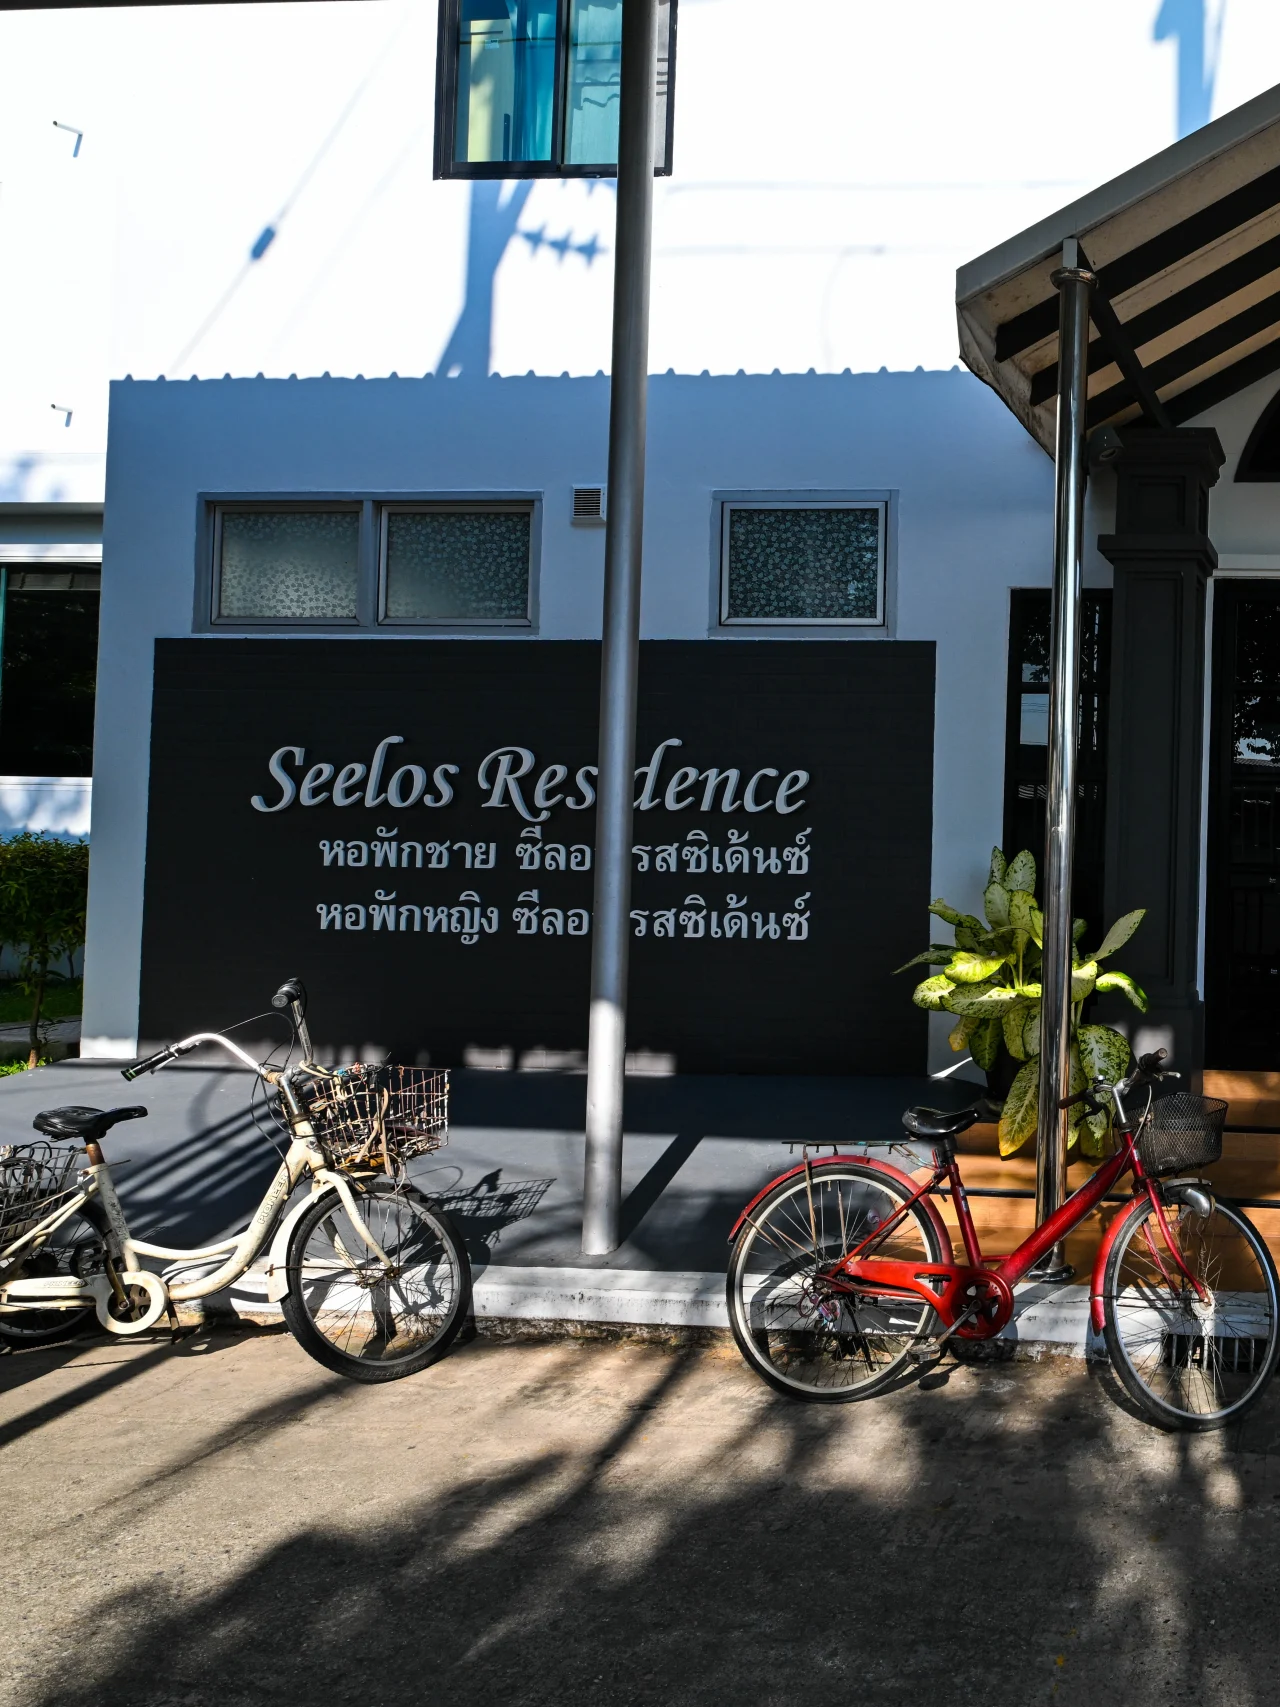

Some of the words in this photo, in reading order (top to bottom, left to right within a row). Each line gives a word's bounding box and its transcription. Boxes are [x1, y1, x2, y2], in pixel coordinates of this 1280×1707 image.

[250, 735, 460, 813] Seelos
[477, 738, 810, 822] Resdence
[318, 826, 497, 869] หอพักชาย
[515, 825, 600, 871] ซีลอ
[625, 827, 813, 875] รสซิเด้นซ์
[316, 889, 499, 945] หอพักหญิง
[512, 889, 598, 936] ซีลอ
[624, 891, 812, 941] รสซิเด้นซ์
